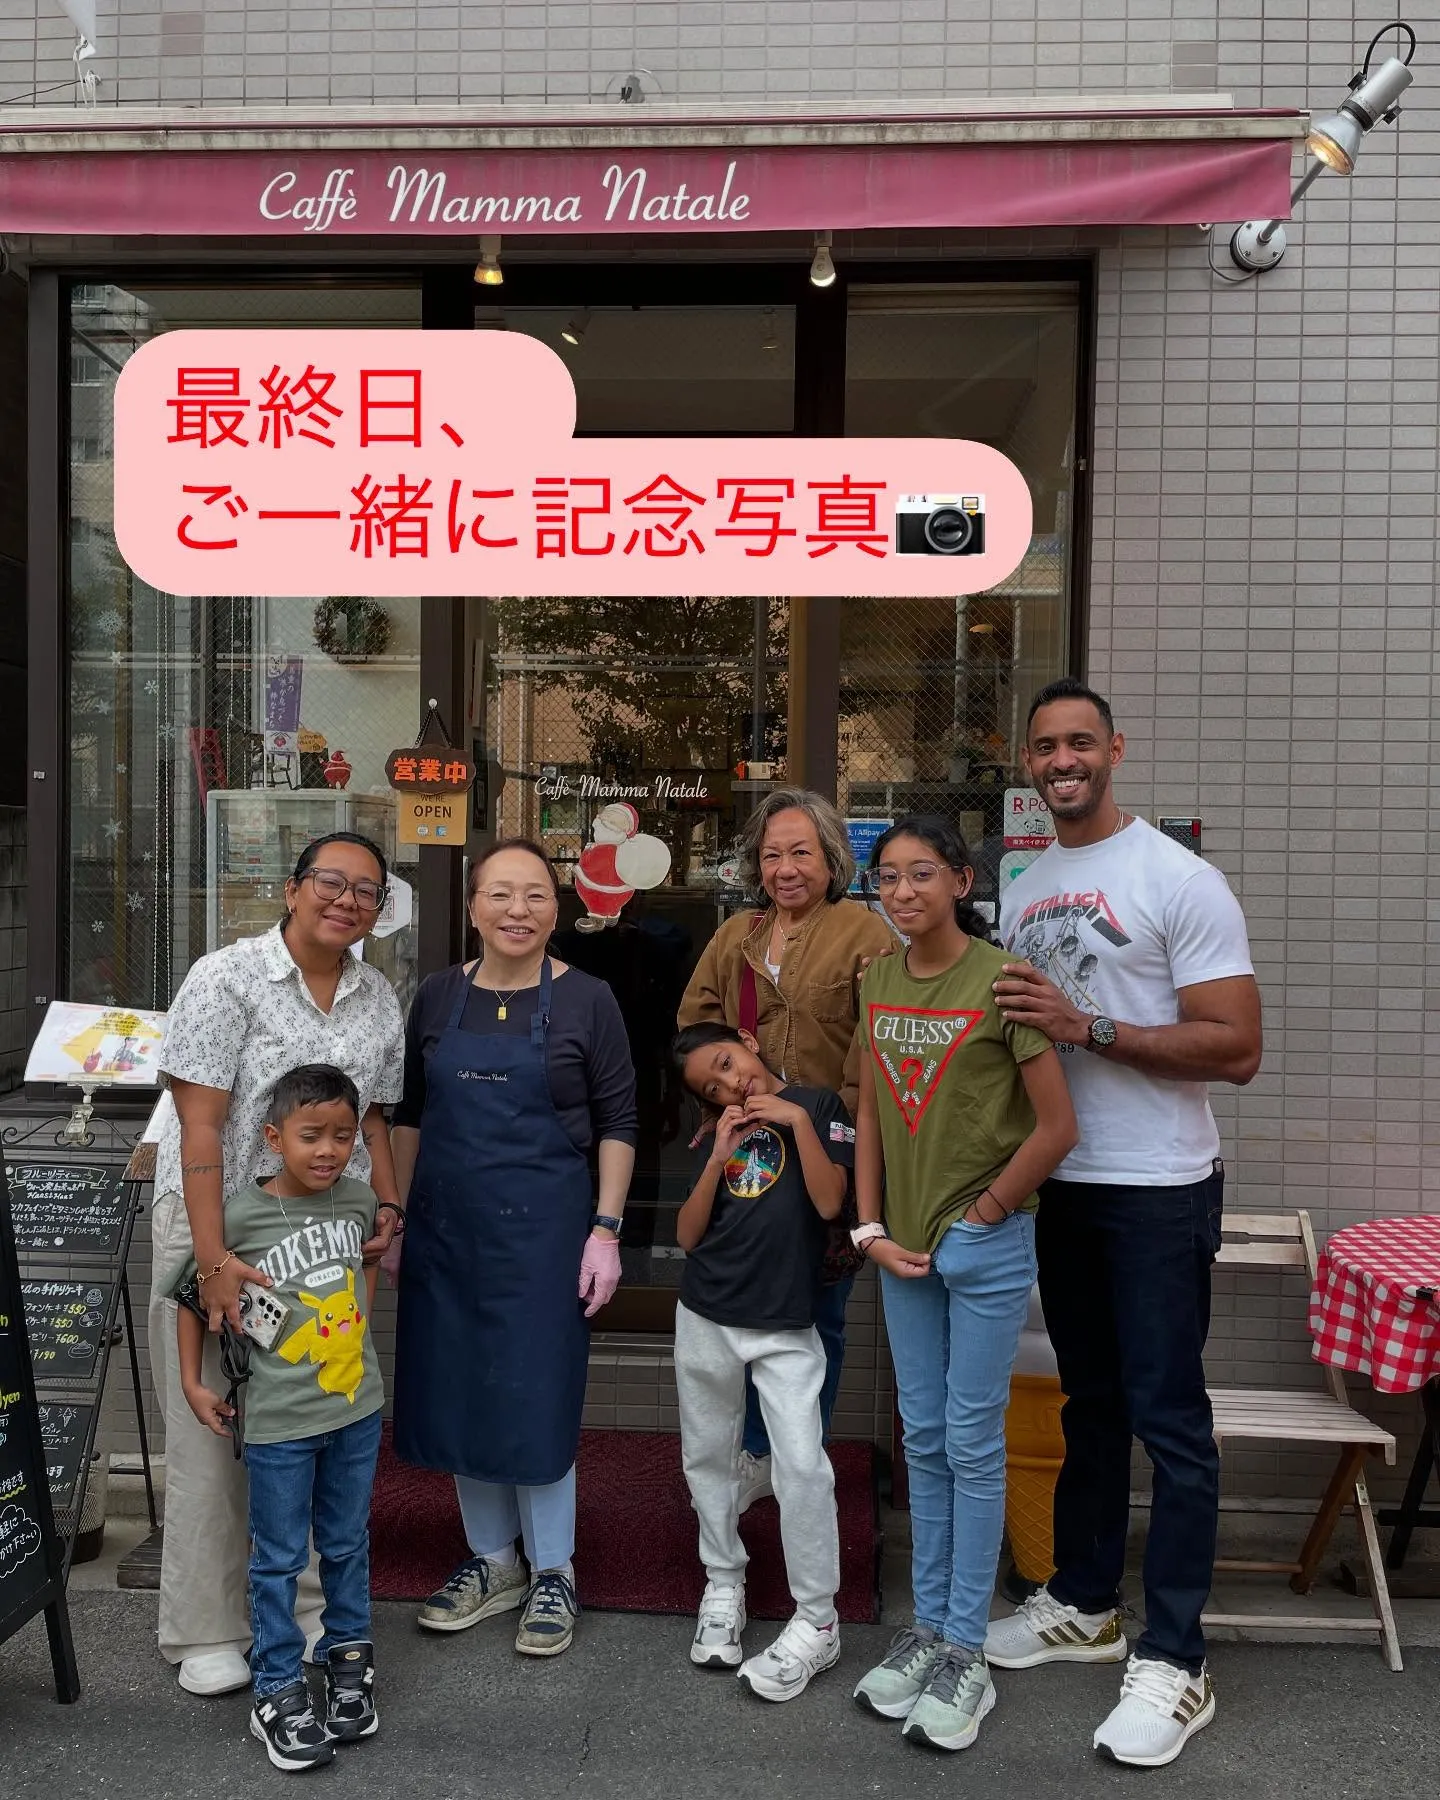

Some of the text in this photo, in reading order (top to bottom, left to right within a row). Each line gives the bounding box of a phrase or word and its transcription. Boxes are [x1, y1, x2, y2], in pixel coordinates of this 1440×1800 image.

[259, 161, 750, 232] Caffè Mamma Natale
[393, 757, 467, 784] 営業中
[534, 774, 708, 800] Caffè Mamma Natale
[413, 805, 452, 818] OPEN
[1029, 797, 1049, 812] Pa
[1008, 888, 1130, 948] METALLICA
[899, 1045, 925, 1054] U.S.A.
[880, 1051, 901, 1085] WASHED
[922, 1059, 937, 1083] JEANS
[256, 1217, 362, 1287] OKÉMO
[21, 1283, 84, 1296] dの手作りケーキ
[24, 1302, 61, 1312] フォンケーキ
